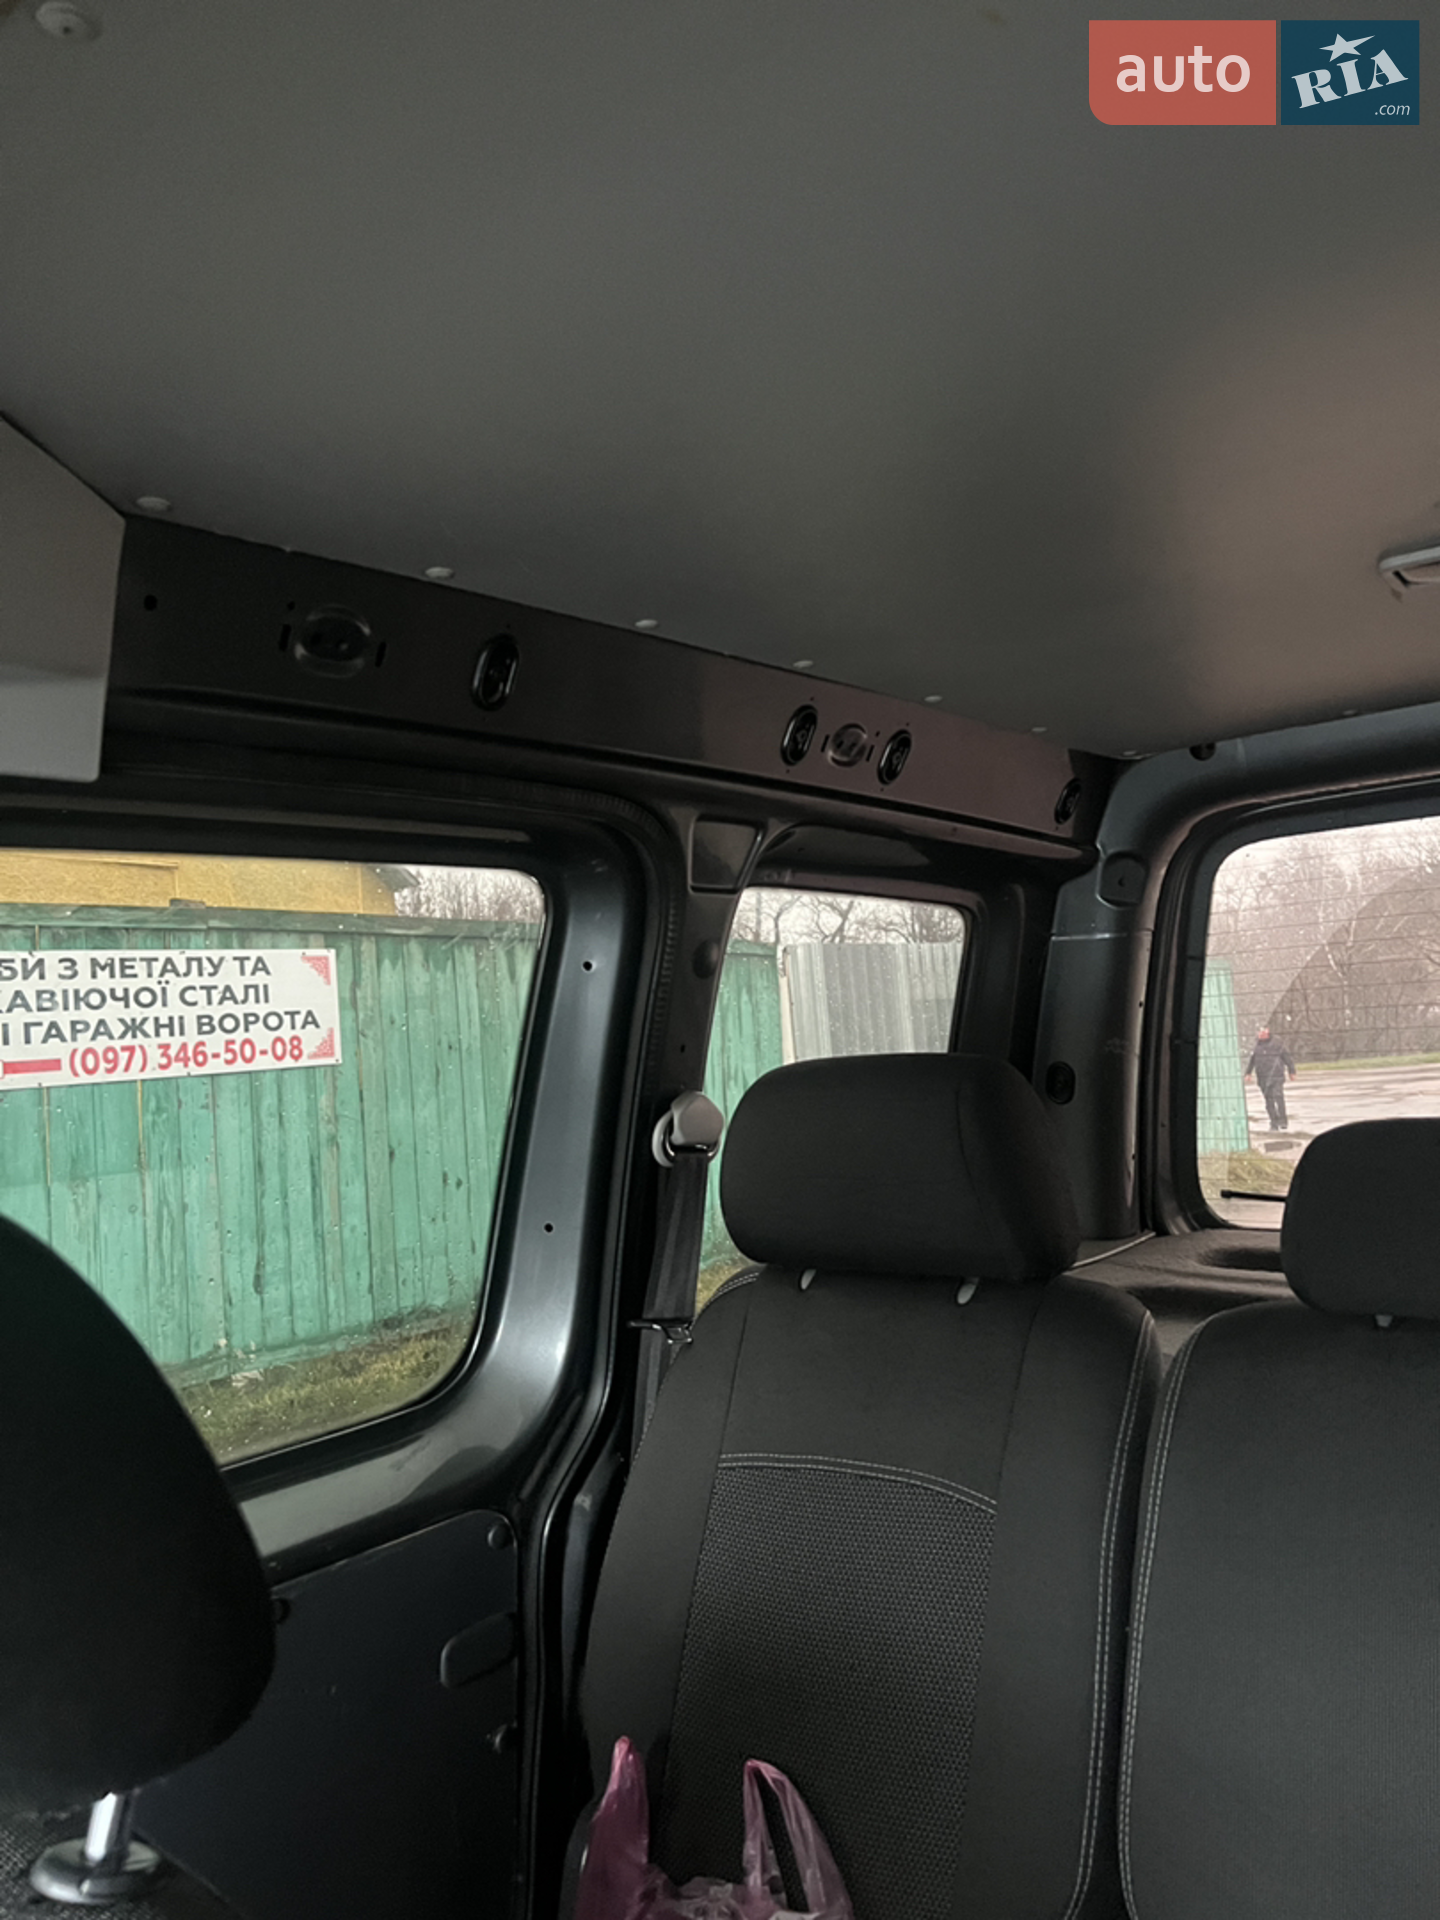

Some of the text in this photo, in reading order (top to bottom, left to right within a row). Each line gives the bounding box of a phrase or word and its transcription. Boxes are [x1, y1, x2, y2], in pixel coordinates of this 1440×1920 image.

[57, 957, 79, 980] З
[89, 956, 226, 980] МЕТАЛУ
[232, 955, 272, 977] ТА
[0, 979, 270, 1014] АВІЮЧОЇ СТАЛІ
[23, 1015, 186, 1045] ГАРАЖНІ
[196, 1009, 321, 1036] ВОРОТА
[69, 1035, 304, 1078] (097) 346-50-08
